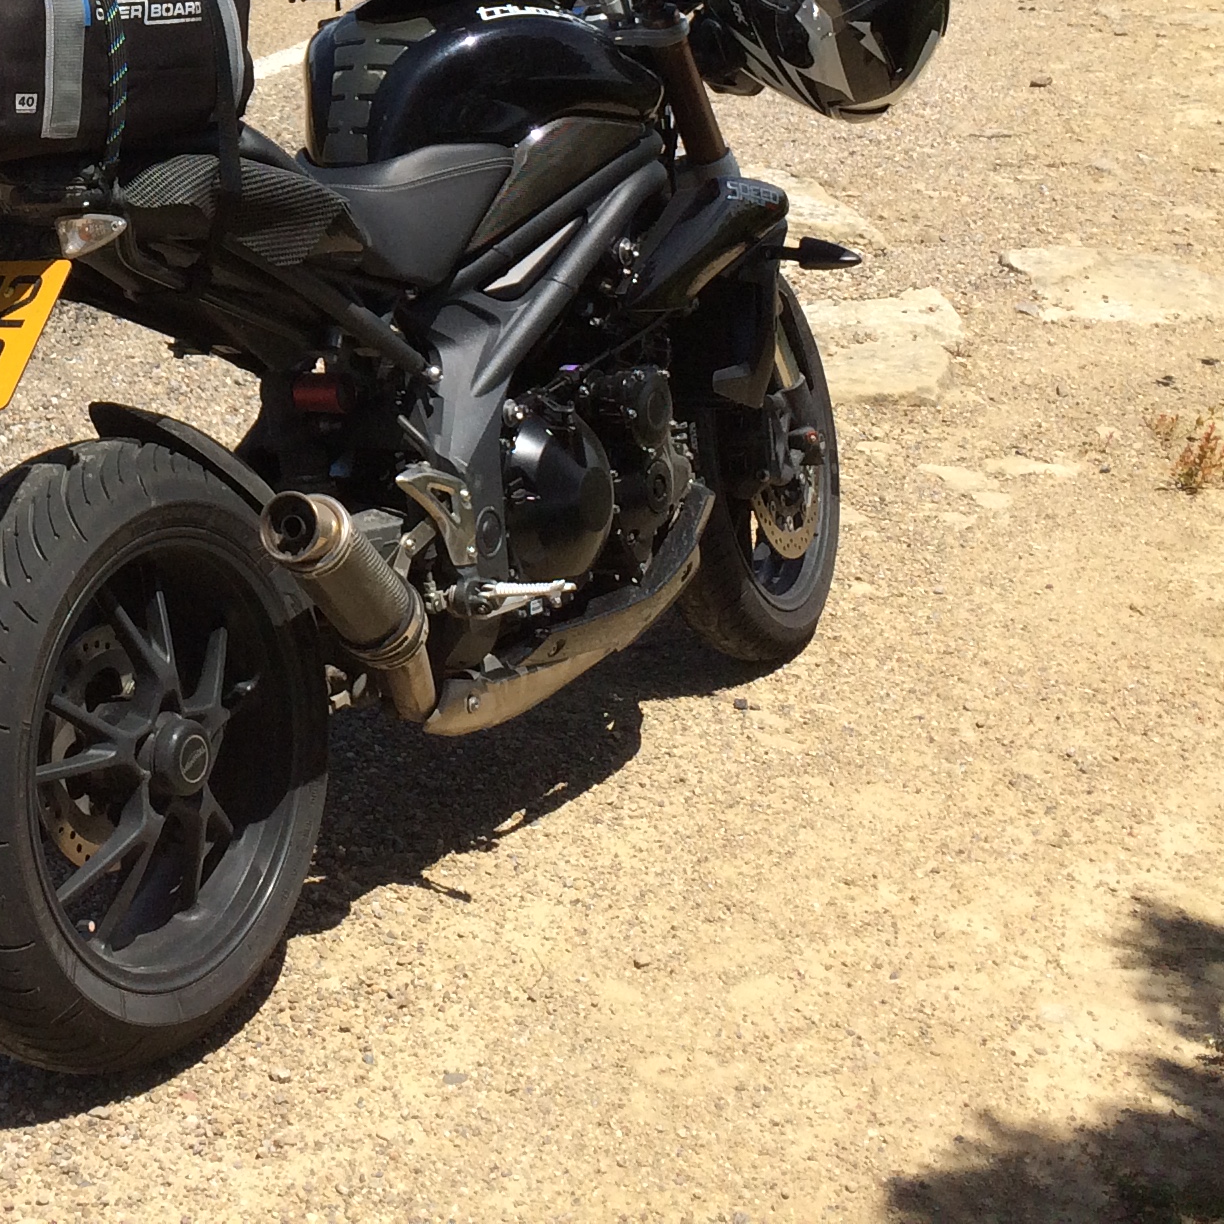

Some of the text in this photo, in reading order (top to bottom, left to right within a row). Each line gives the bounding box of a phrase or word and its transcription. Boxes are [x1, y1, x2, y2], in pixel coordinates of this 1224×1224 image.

[96, 5, 143, 21] OER
[18, 96, 35, 107] 40
[726, 180, 779, 205] SPEED
